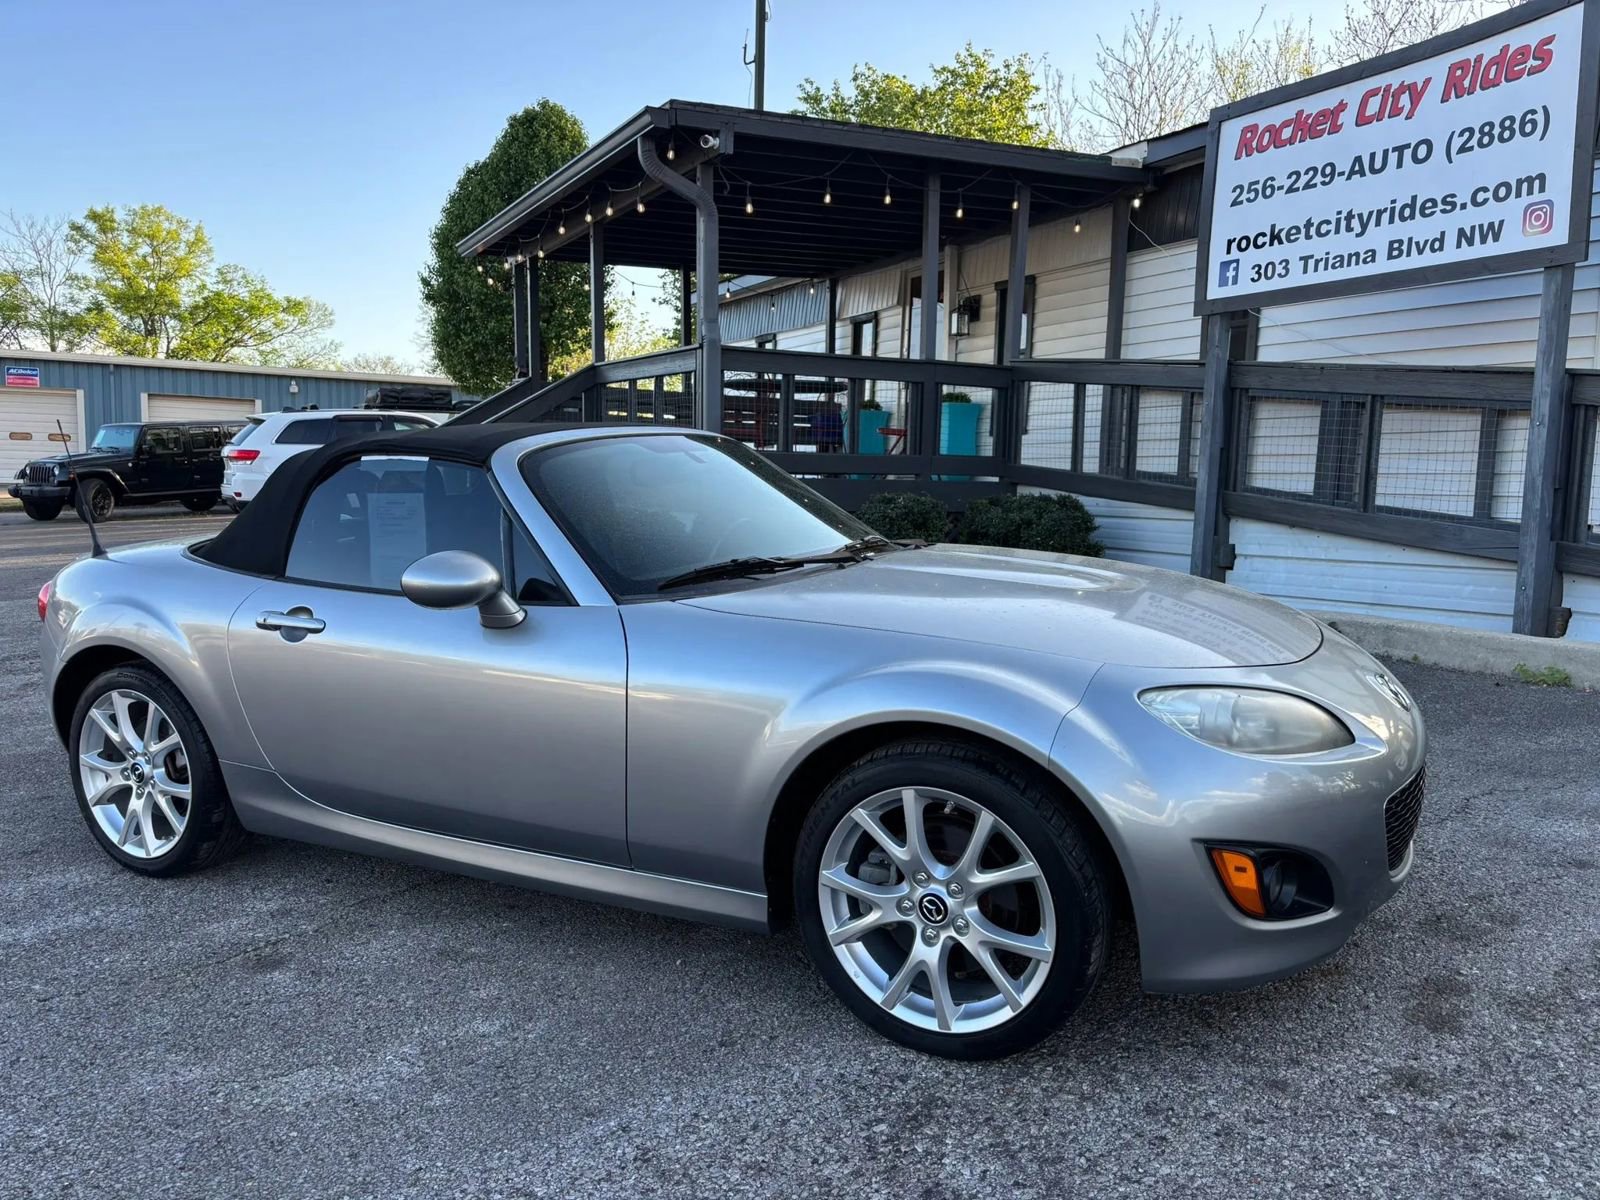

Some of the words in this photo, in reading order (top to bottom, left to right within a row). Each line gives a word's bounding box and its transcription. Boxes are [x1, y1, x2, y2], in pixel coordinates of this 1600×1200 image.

[1234, 99, 1348, 160] Rocket
[1355, 77, 1432, 127] City
[1440, 34, 1556, 104] Rides
[1229, 138, 1434, 207] 256-229-AUTO
[1445, 105, 1550, 164] (2886)
[1226, 172, 1547, 255] rocketcityrides.com
[1250, 258, 1290, 283] 303
[1299, 248, 1377, 275] Triana
[1386, 231, 1446, 261] Blvd
[1455, 219, 1505, 249] NW
